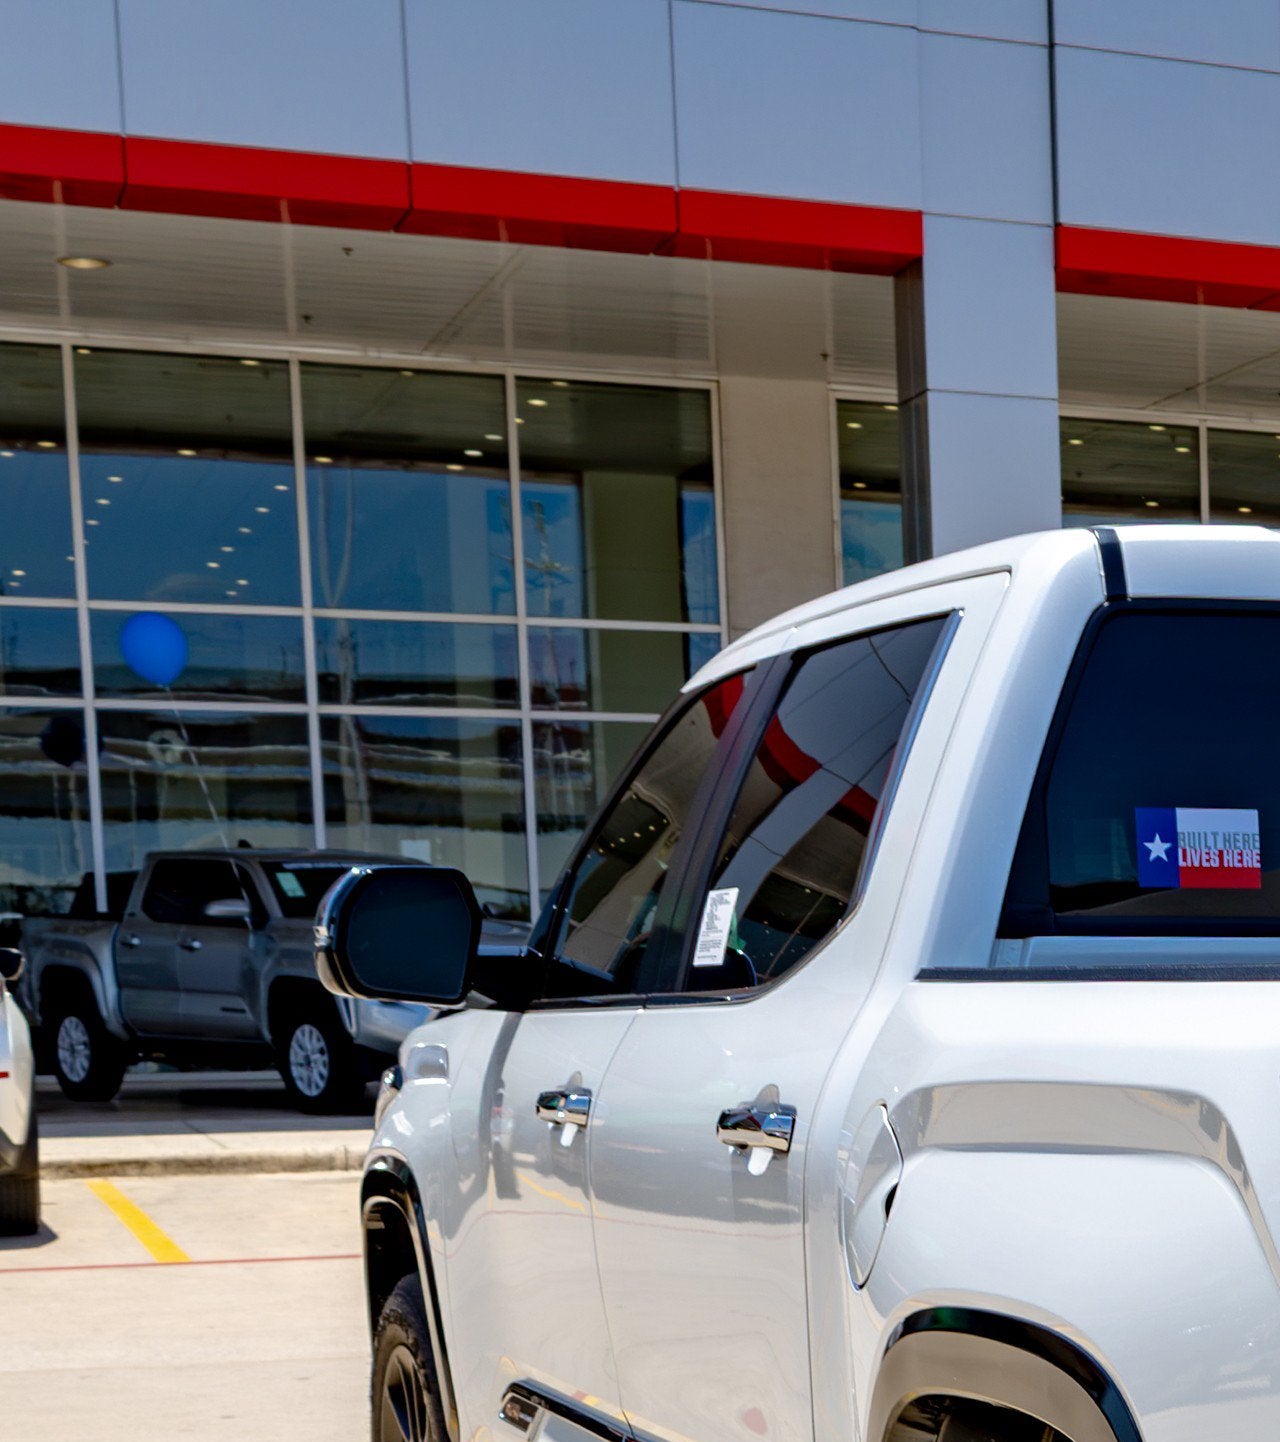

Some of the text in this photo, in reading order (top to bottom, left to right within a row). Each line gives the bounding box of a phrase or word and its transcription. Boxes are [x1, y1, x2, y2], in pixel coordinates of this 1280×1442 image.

[1178, 831, 1260, 850] BUILT HERE
[1178, 848, 1261, 868] LIVES HERE
